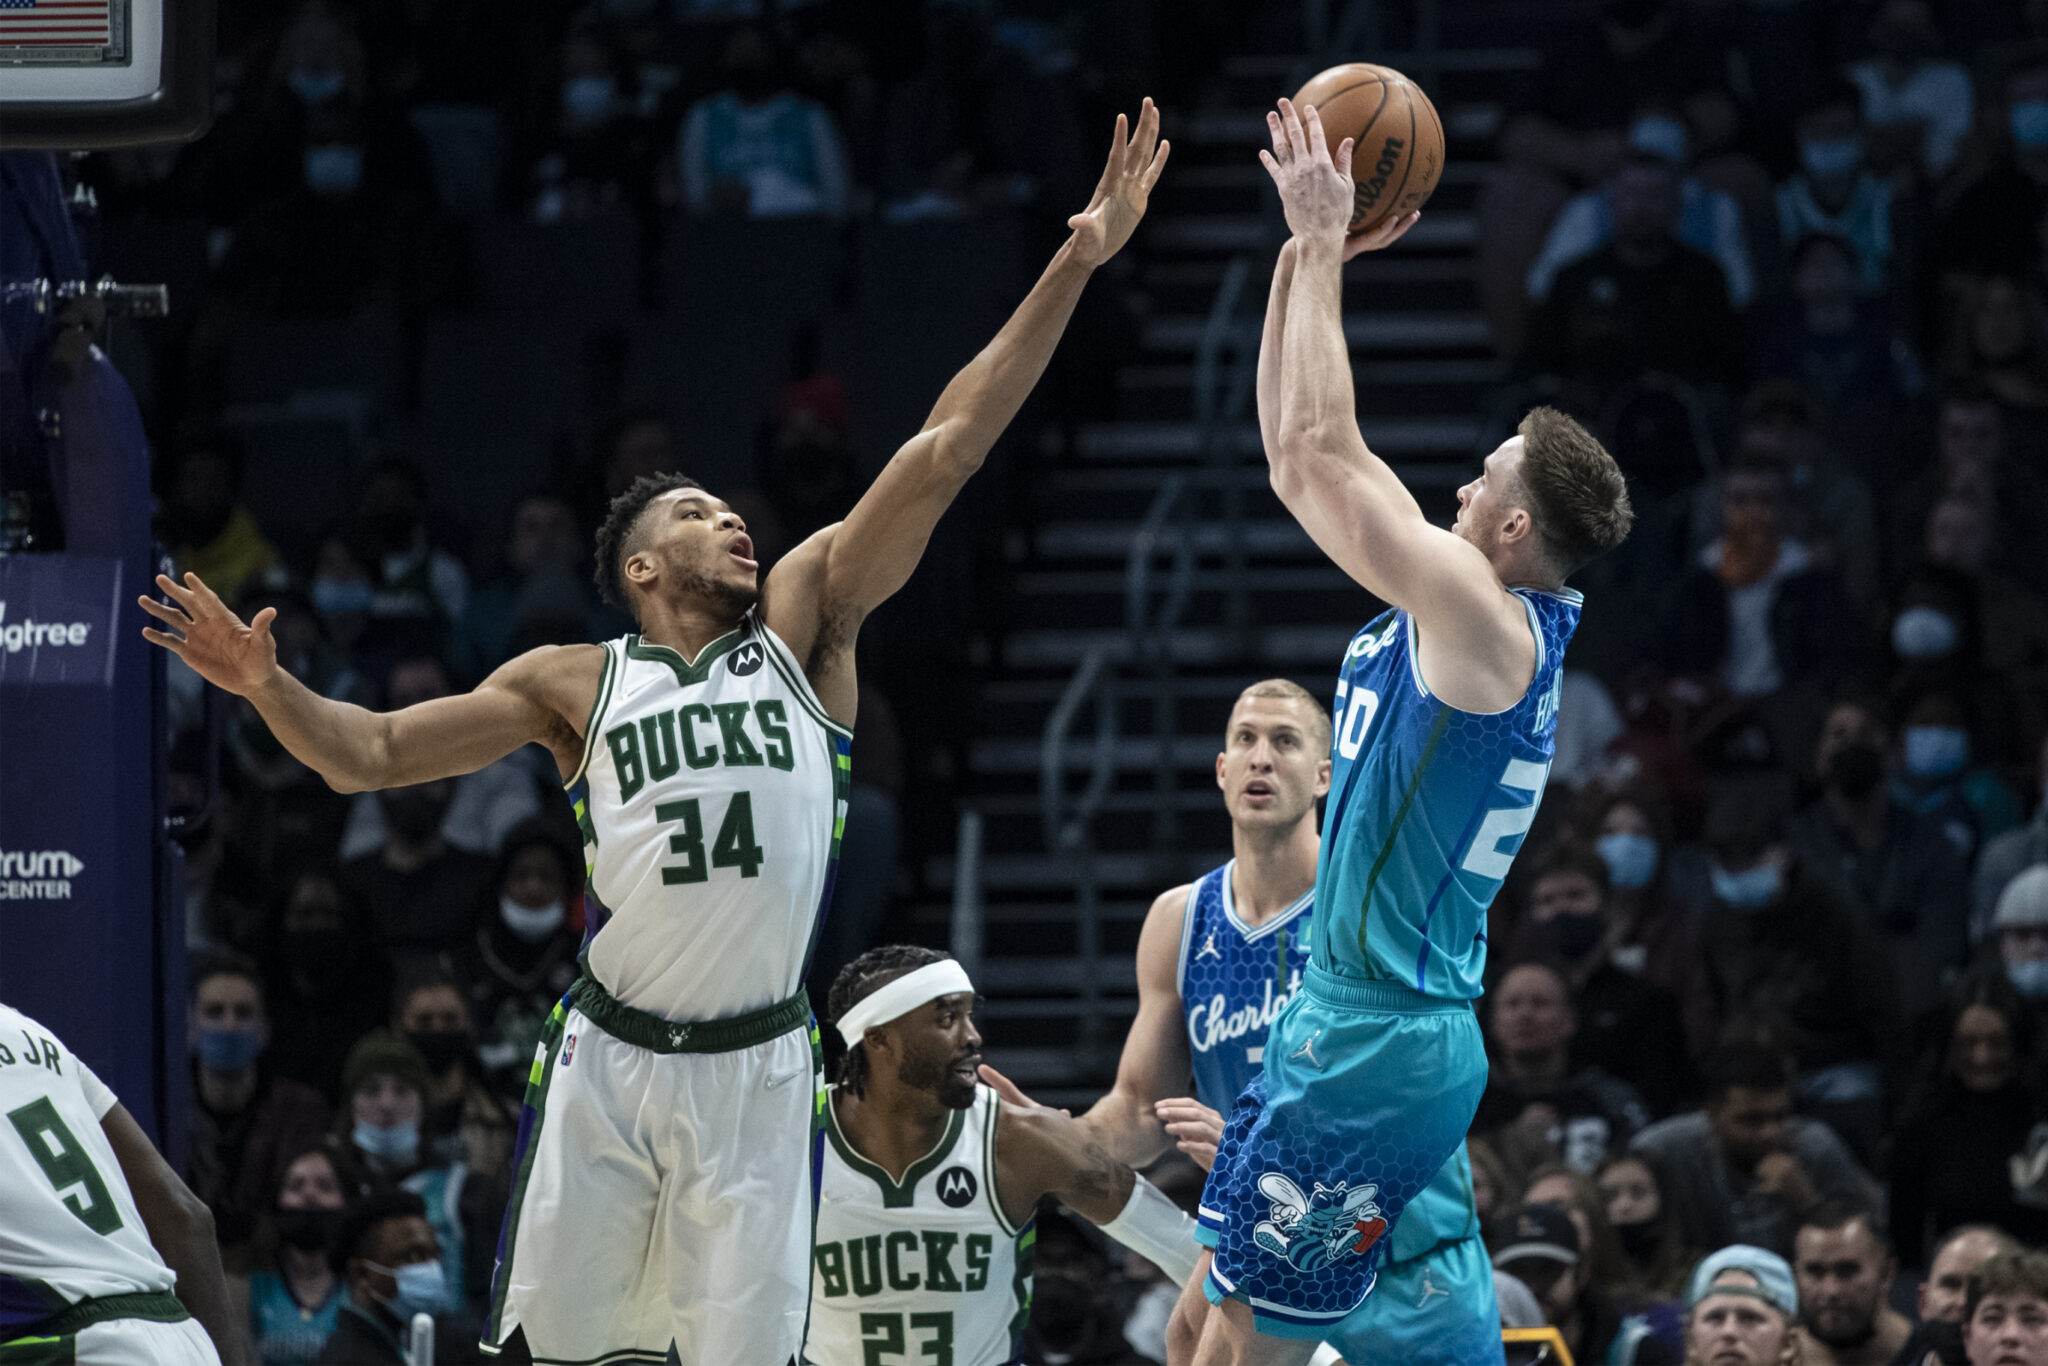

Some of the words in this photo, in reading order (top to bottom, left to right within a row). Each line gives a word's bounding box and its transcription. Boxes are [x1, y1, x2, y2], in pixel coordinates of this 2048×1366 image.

[605, 699, 795, 806] BUCKS
[654, 790, 765, 886] 34
[21, 1029, 62, 1077] JR
[6, 1095, 124, 1237] 9
[815, 1229, 993, 1298] BUCKS
[858, 1310, 954, 1366] 23
